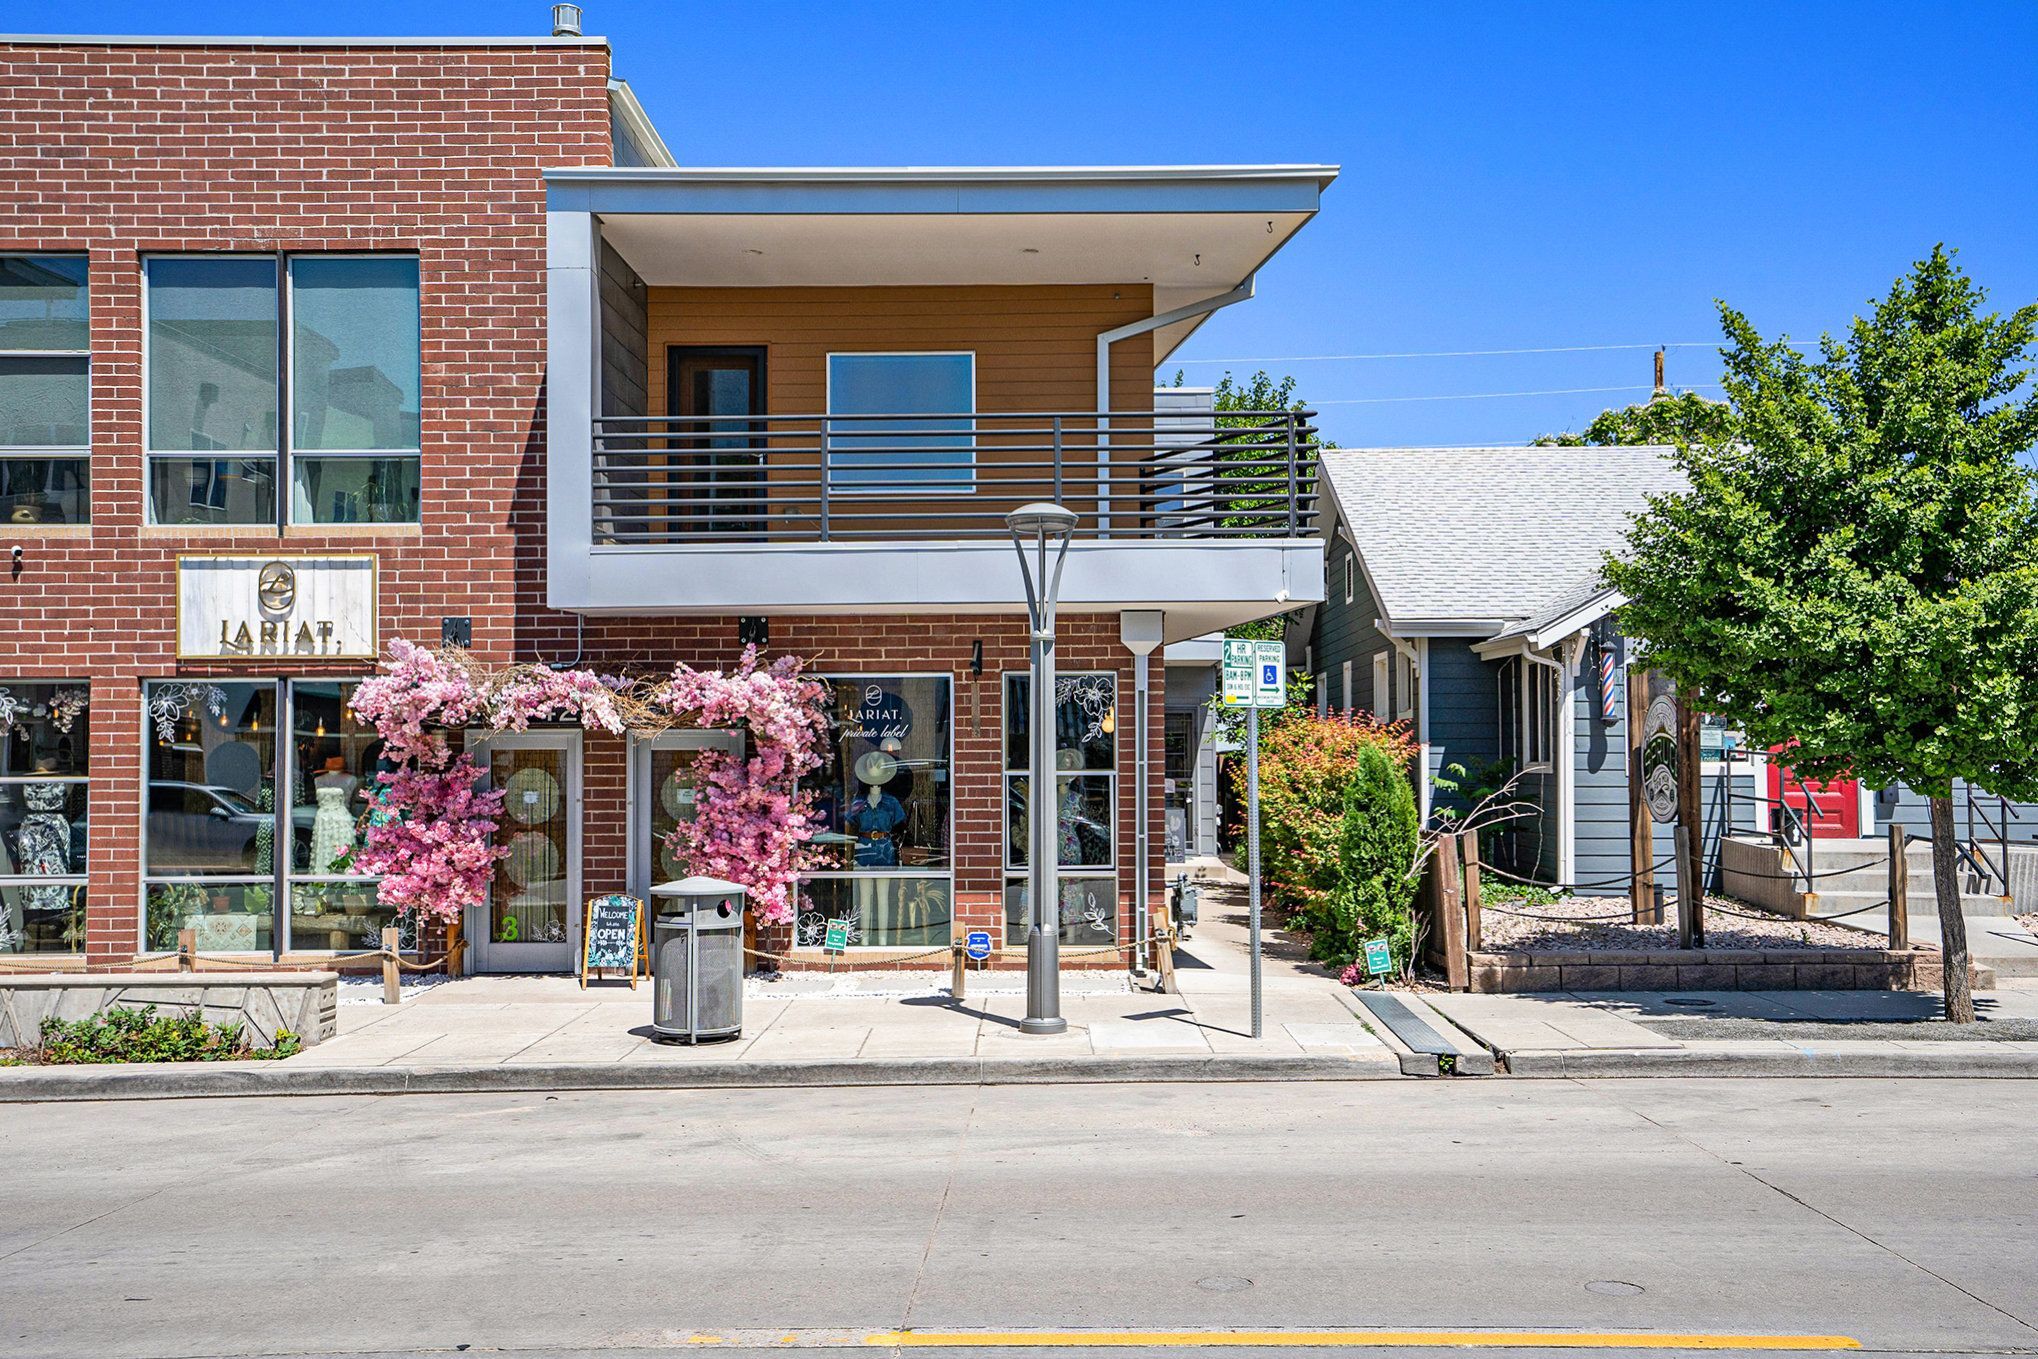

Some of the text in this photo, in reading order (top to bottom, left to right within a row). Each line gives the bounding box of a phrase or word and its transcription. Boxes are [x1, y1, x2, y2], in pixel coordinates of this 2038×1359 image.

[1224, 644, 1246, 662] 2 HR
[1257, 644, 1281, 653] RESERVED
[1231, 654, 1252, 666] PARKING
[1259, 654, 1280, 663] PARKING
[838, 728, 878, 742] private
[880, 724, 909, 738] label
[600, 908, 628, 920] WELCOME
[598, 928, 626, 940] OPEN
